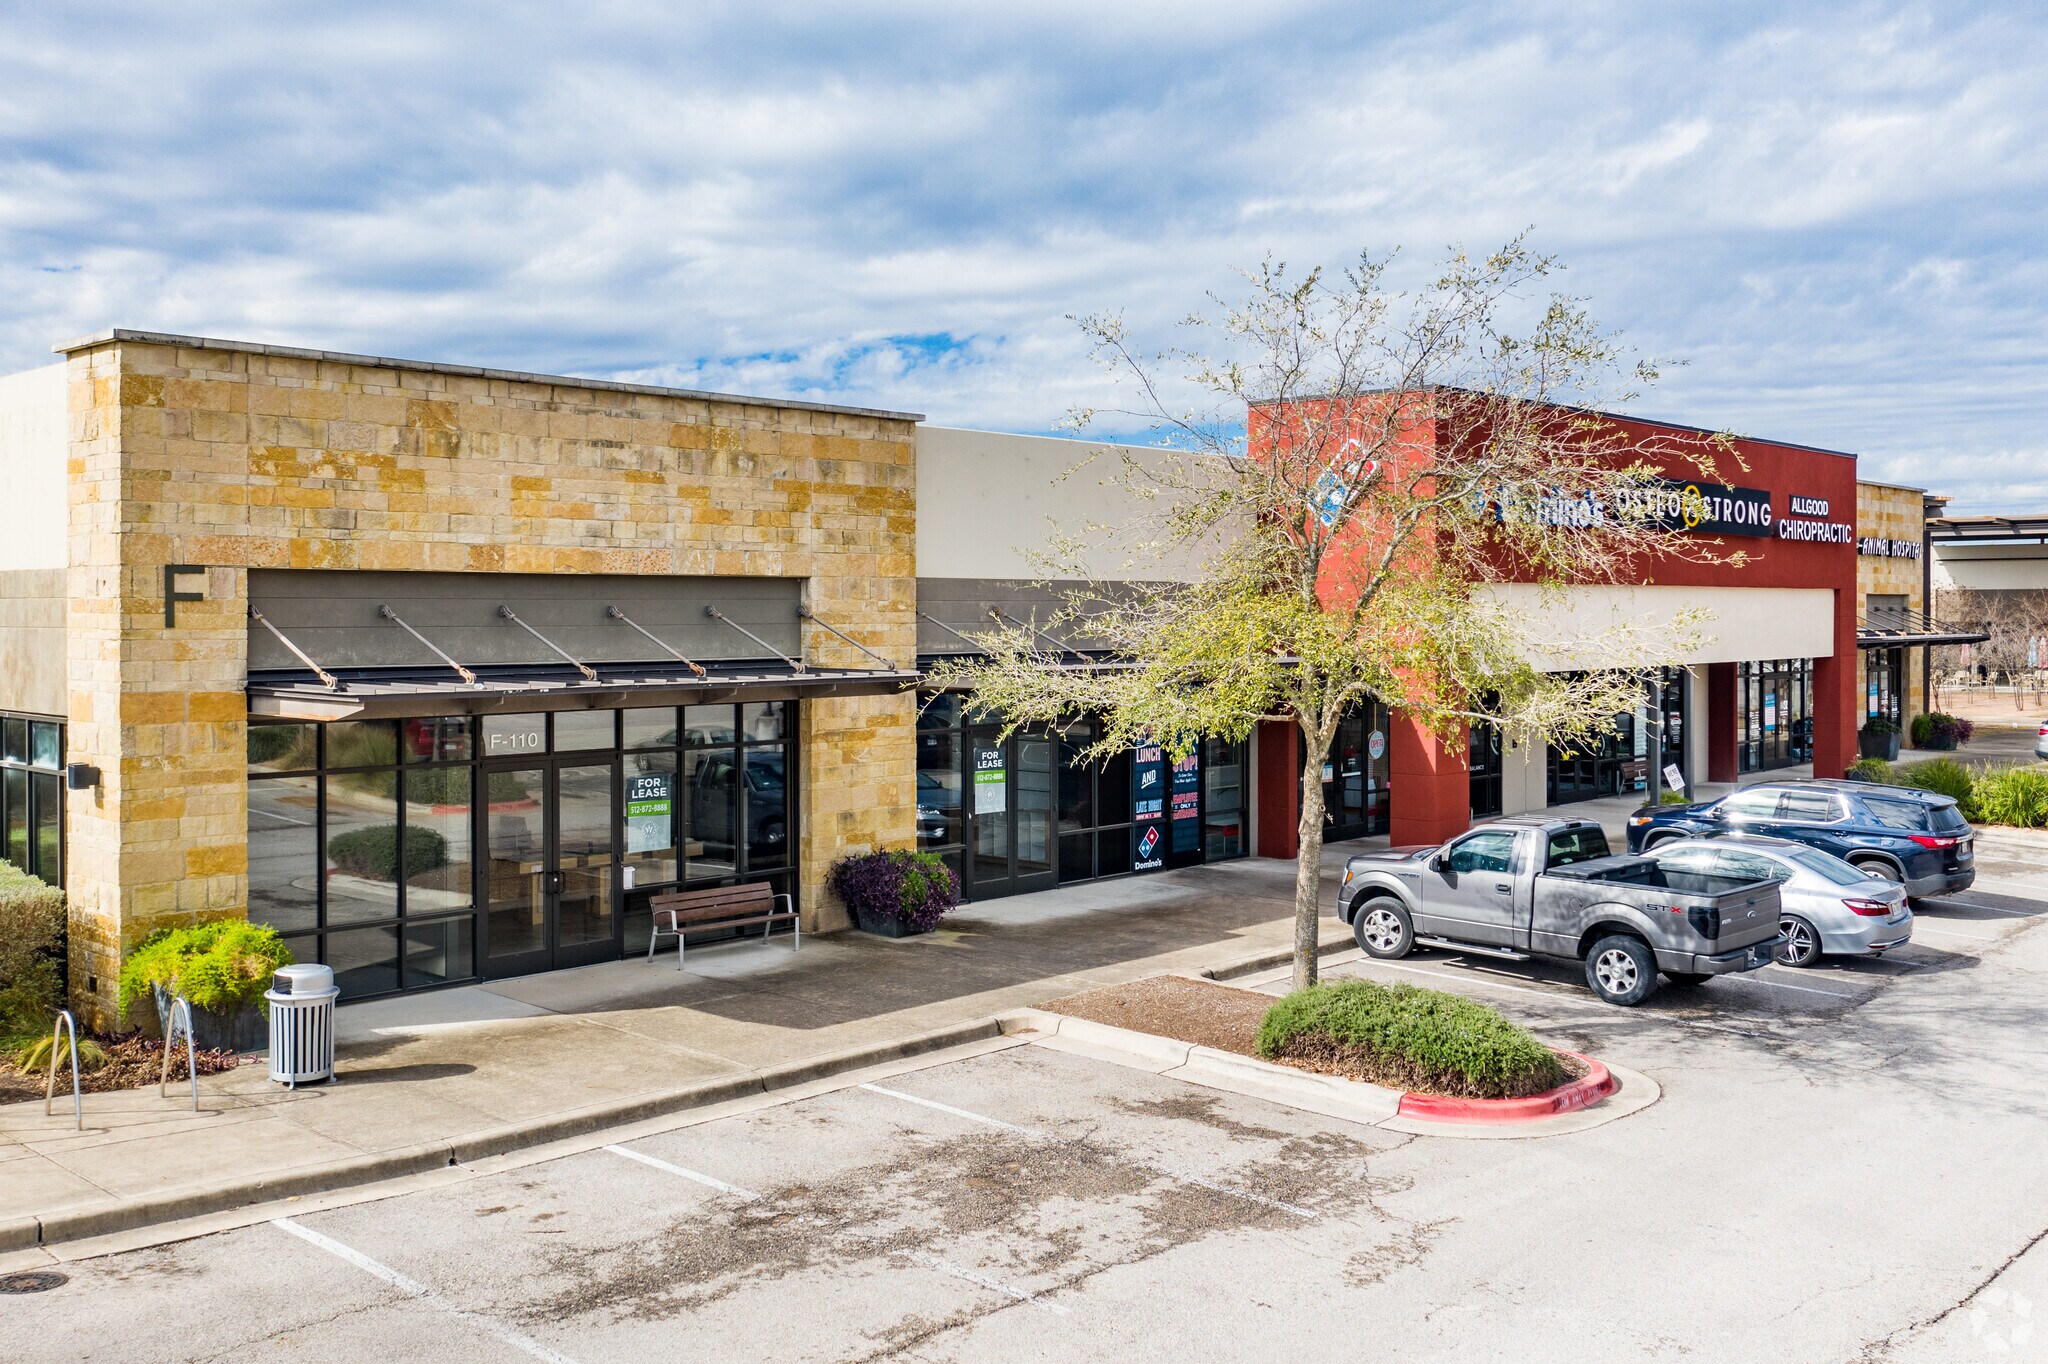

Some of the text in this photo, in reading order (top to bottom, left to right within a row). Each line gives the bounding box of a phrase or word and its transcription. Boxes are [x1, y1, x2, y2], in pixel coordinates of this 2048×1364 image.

[1702, 496, 1771, 526] STRONG
[1791, 496, 1829, 516] ALLGOOD
[1779, 518, 1852, 544] CHIROPRACTIC
[1862, 537, 1923, 559] ANIMAL HOSPITAL
[165, 565, 205, 628] F
[490, 732, 538, 749] F-110
[1370, 738, 1384, 749] OPEN
[981, 751, 999, 760] FOR
[1136, 747, 1161, 763] LUNCH
[977, 759, 1003, 769] LEASE
[637, 778, 661, 788] FOR
[1141, 769, 1157, 785] AND
[631, 787, 667, 799] LEASE
[630, 803, 668, 814] 512-872-8888
[1134, 858, 1162, 870] Domino's
[1646, 903, 1682, 914] STX
